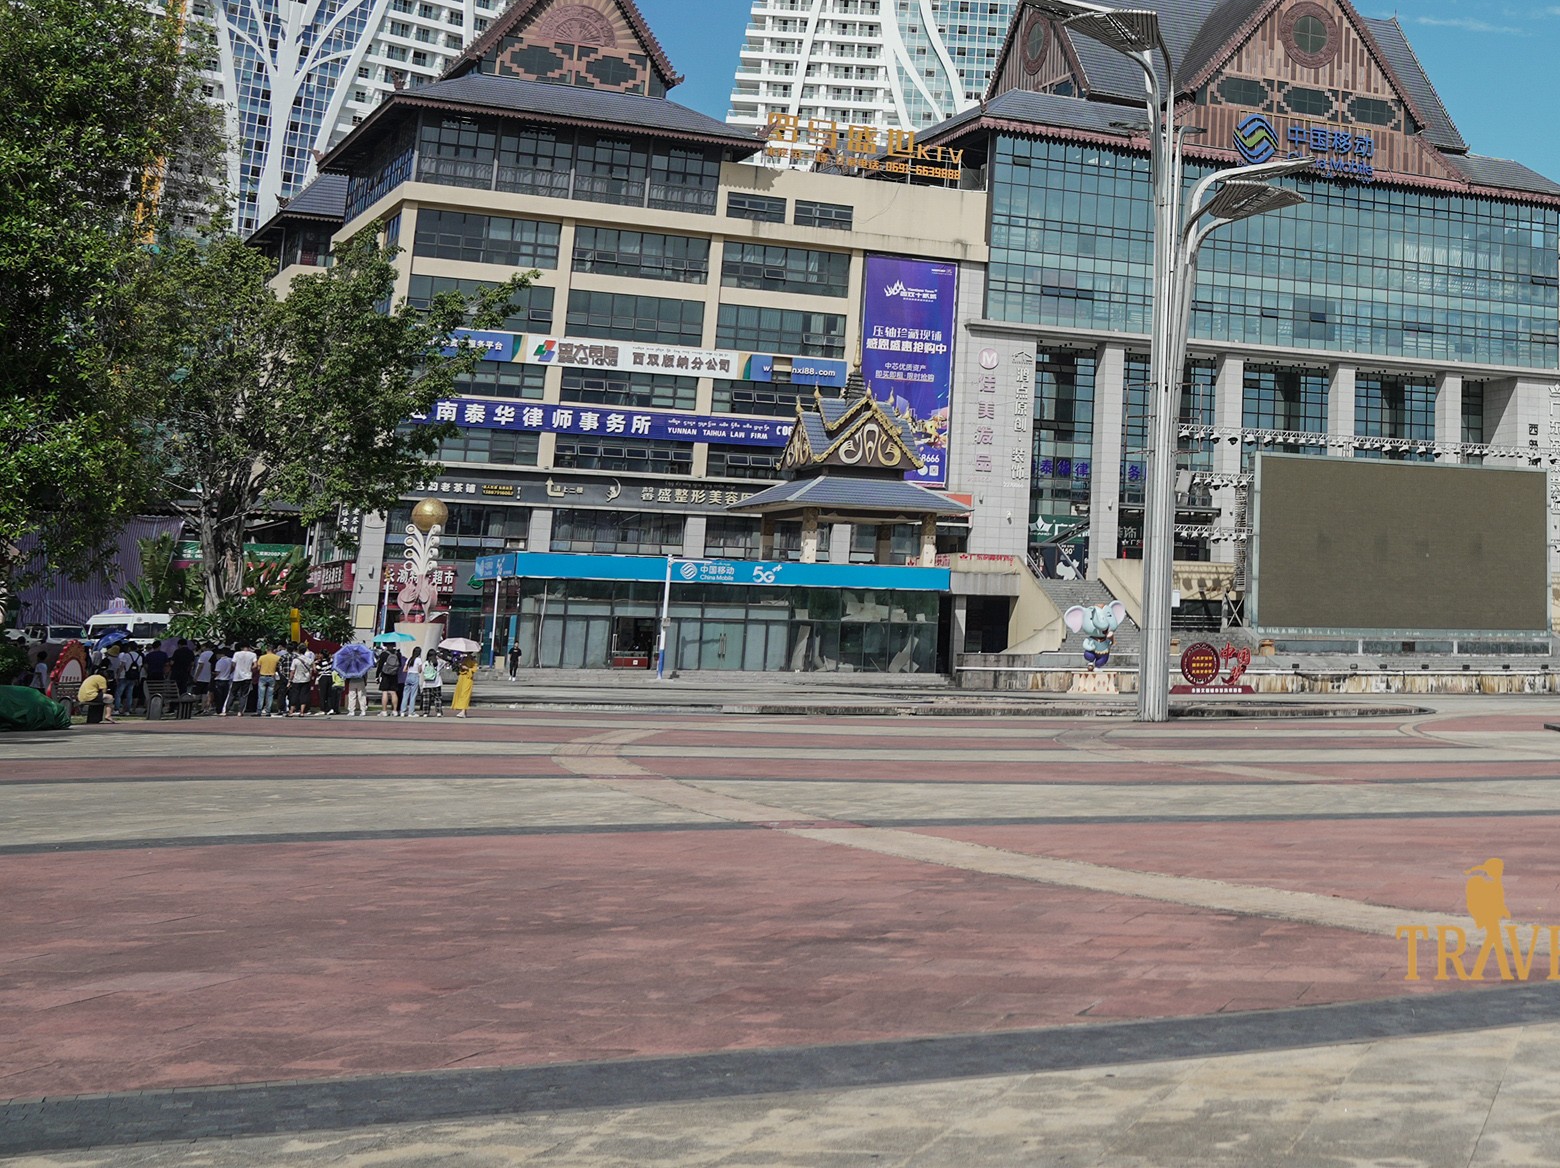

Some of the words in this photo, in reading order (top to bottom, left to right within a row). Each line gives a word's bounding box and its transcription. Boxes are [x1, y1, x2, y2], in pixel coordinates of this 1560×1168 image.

[1287, 125, 1375, 158] 中国移动
[1329, 157, 1374, 176] Mobile
[632, 352, 731, 373] 西双版纳分公司
[667, 426, 697, 436] YUNNAN
[702, 429, 726, 438] TAIHUA
[730, 430, 745, 439] LAW
[750, 432, 768, 440] FIRM
[919, 453, 940, 463] 8666
[700, 565, 735, 576] 中国移动
[700, 573, 716, 582] China
[716, 574, 734, 582] Mobile
